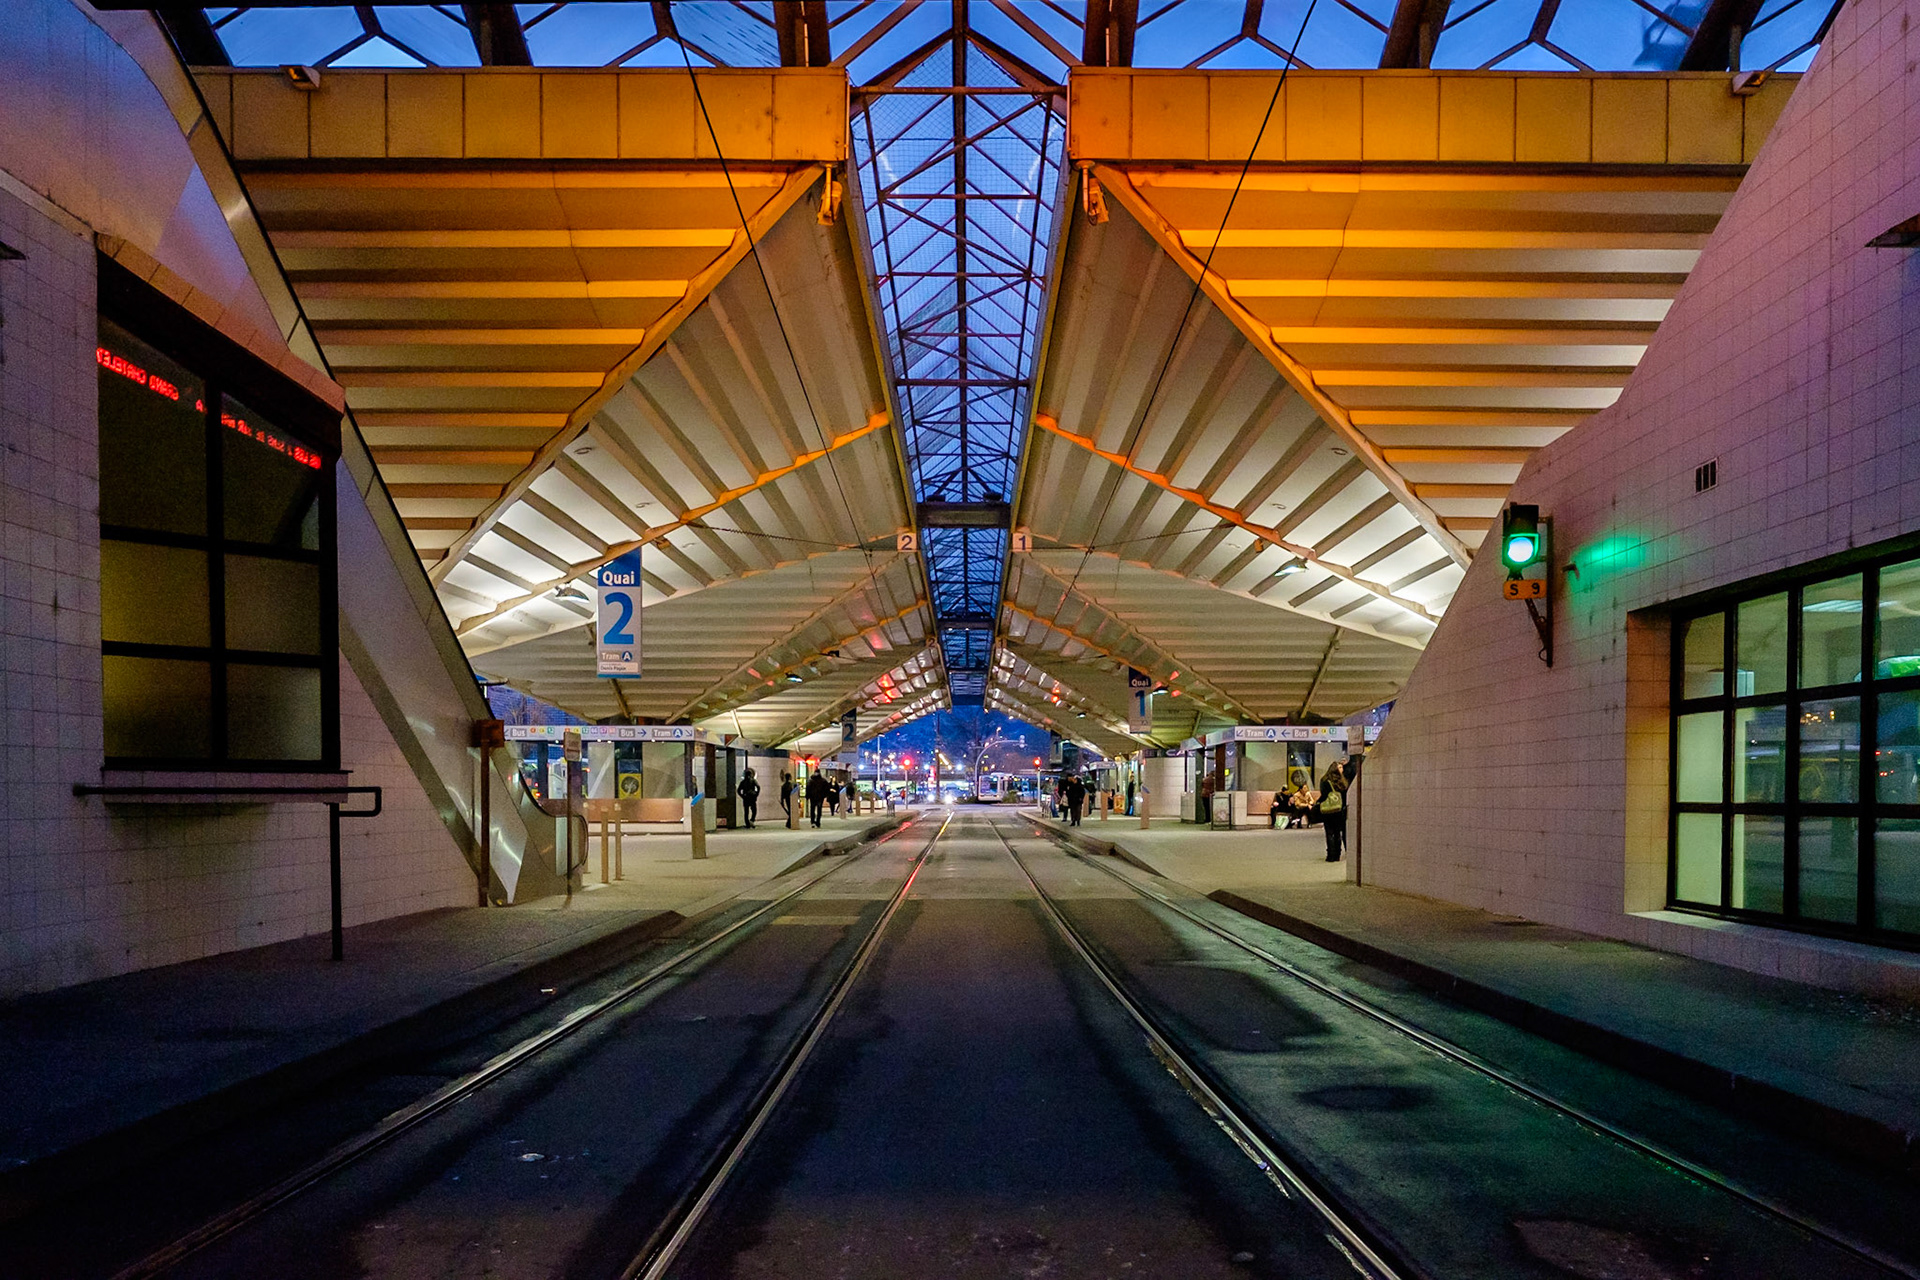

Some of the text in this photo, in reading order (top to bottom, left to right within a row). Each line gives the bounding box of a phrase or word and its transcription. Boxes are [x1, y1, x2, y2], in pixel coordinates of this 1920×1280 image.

[901, 535, 913, 551] 2
[1018, 535, 1027, 551] 1
[602, 571, 634, 586] Quai
[1510, 582, 1540, 596] S 9
[603, 591, 634, 645] 2
[602, 652, 631, 660] Tram A
[1131, 678, 1149, 687] Quai
[1135, 690, 1145, 717] 1
[512, 728, 525, 737] Bus
[620, 728, 634, 737] Bus
[653, 729, 671, 737] Tram
[674, 728, 682, 737] A
[844, 723, 854, 742] 2
[1246, 729, 1264, 737] Tram
[1267, 729, 1275, 737] A
[1294, 729, 1308, 737] Bus
